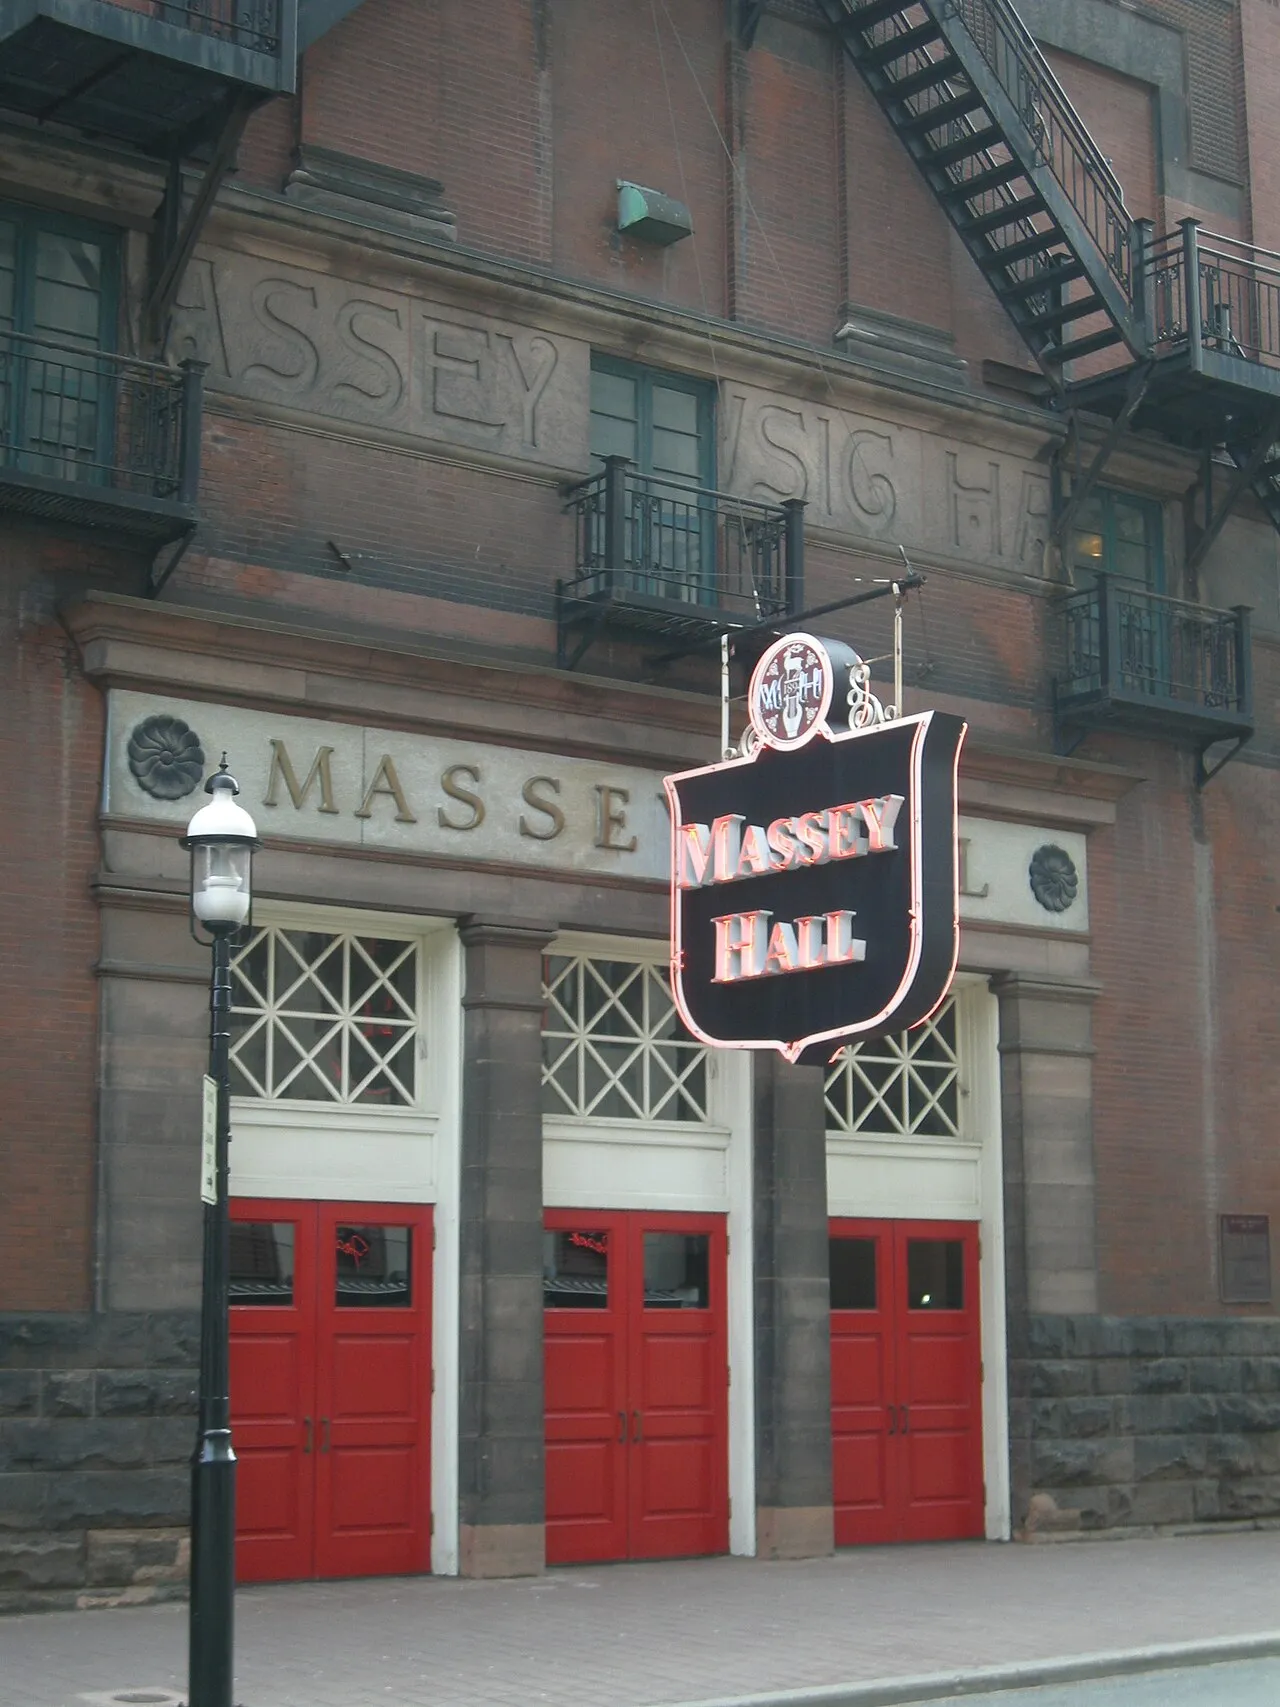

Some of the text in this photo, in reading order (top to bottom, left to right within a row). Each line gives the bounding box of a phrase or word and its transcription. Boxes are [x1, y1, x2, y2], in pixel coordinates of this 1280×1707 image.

[262, 738, 670, 852] MASSE
[677, 793, 905, 890] MASSEY
[709, 909, 867, 984] HALL
